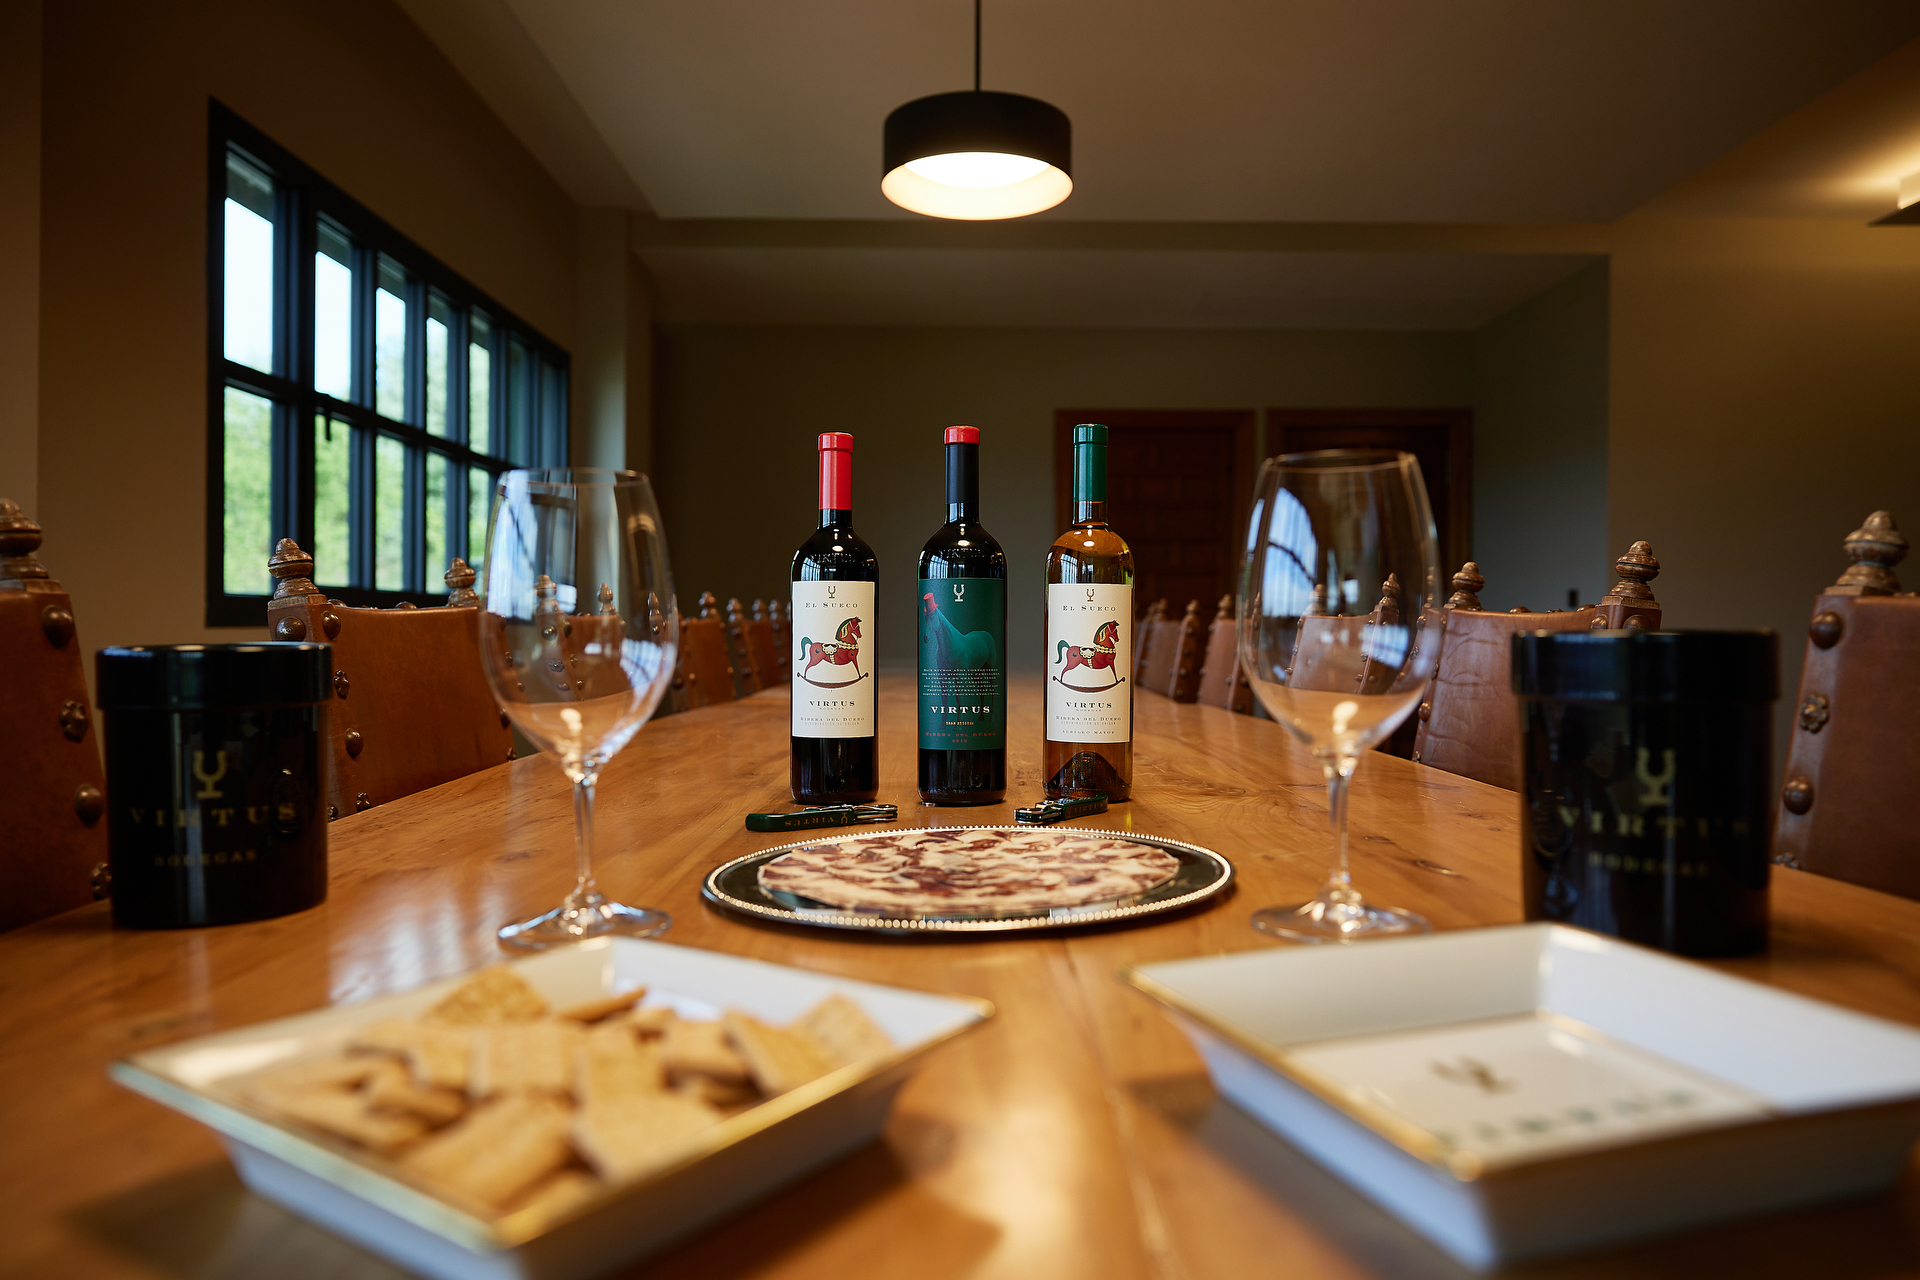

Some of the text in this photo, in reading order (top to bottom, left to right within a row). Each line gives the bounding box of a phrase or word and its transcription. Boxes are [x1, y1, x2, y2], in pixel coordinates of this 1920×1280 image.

[930, 705, 991, 714] VIRTUS
[1073, 803, 1104, 813] VIRTUS
[129, 802, 296, 828] VIRTUS
[784, 817, 835, 828] VIRTUS
